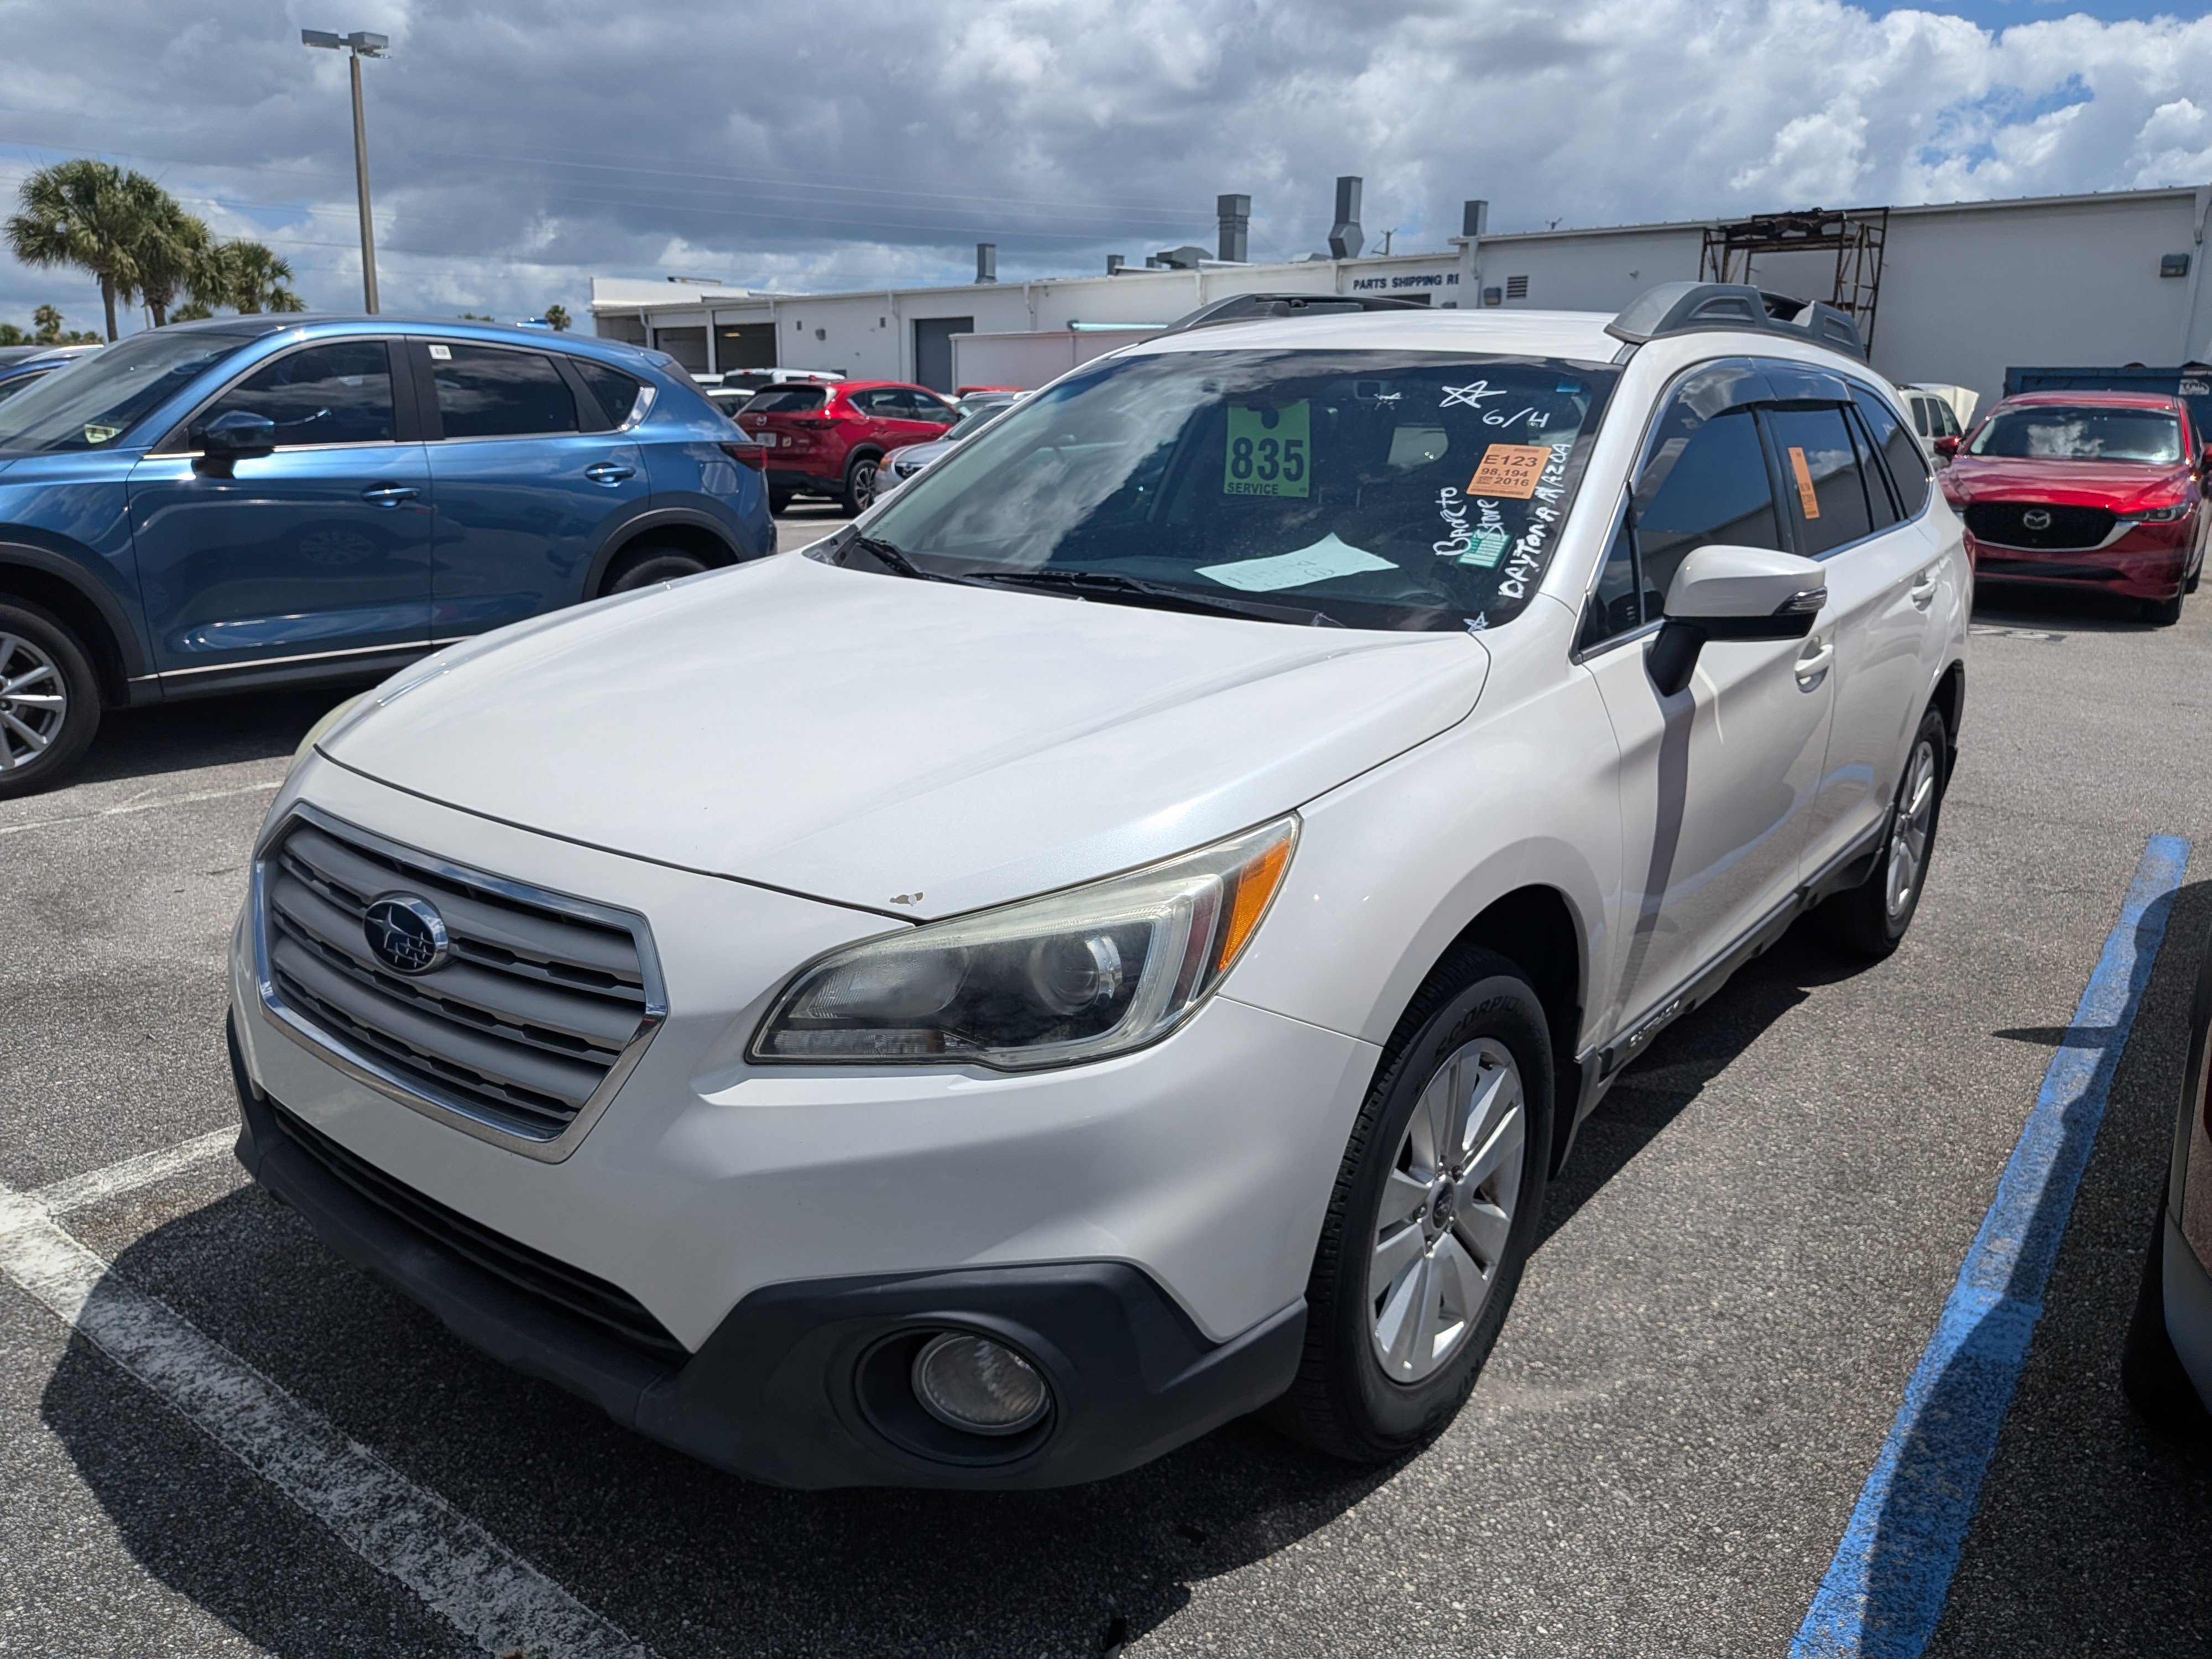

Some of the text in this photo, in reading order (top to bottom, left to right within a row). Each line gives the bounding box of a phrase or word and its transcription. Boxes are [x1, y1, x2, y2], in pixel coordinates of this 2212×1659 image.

[1353, 278, 1386, 290] PARTS
[1391, 274, 1442, 288] SHIPPING
[1482, 407, 1550, 428] 6/4
[1231, 437, 1304, 482] 835
[1483, 454, 1538, 467] E123
[1227, 482, 1279, 495] SERVICE
[1494, 477, 1530, 487] 2016
[1498, 506, 1561, 599] DAYTONA
